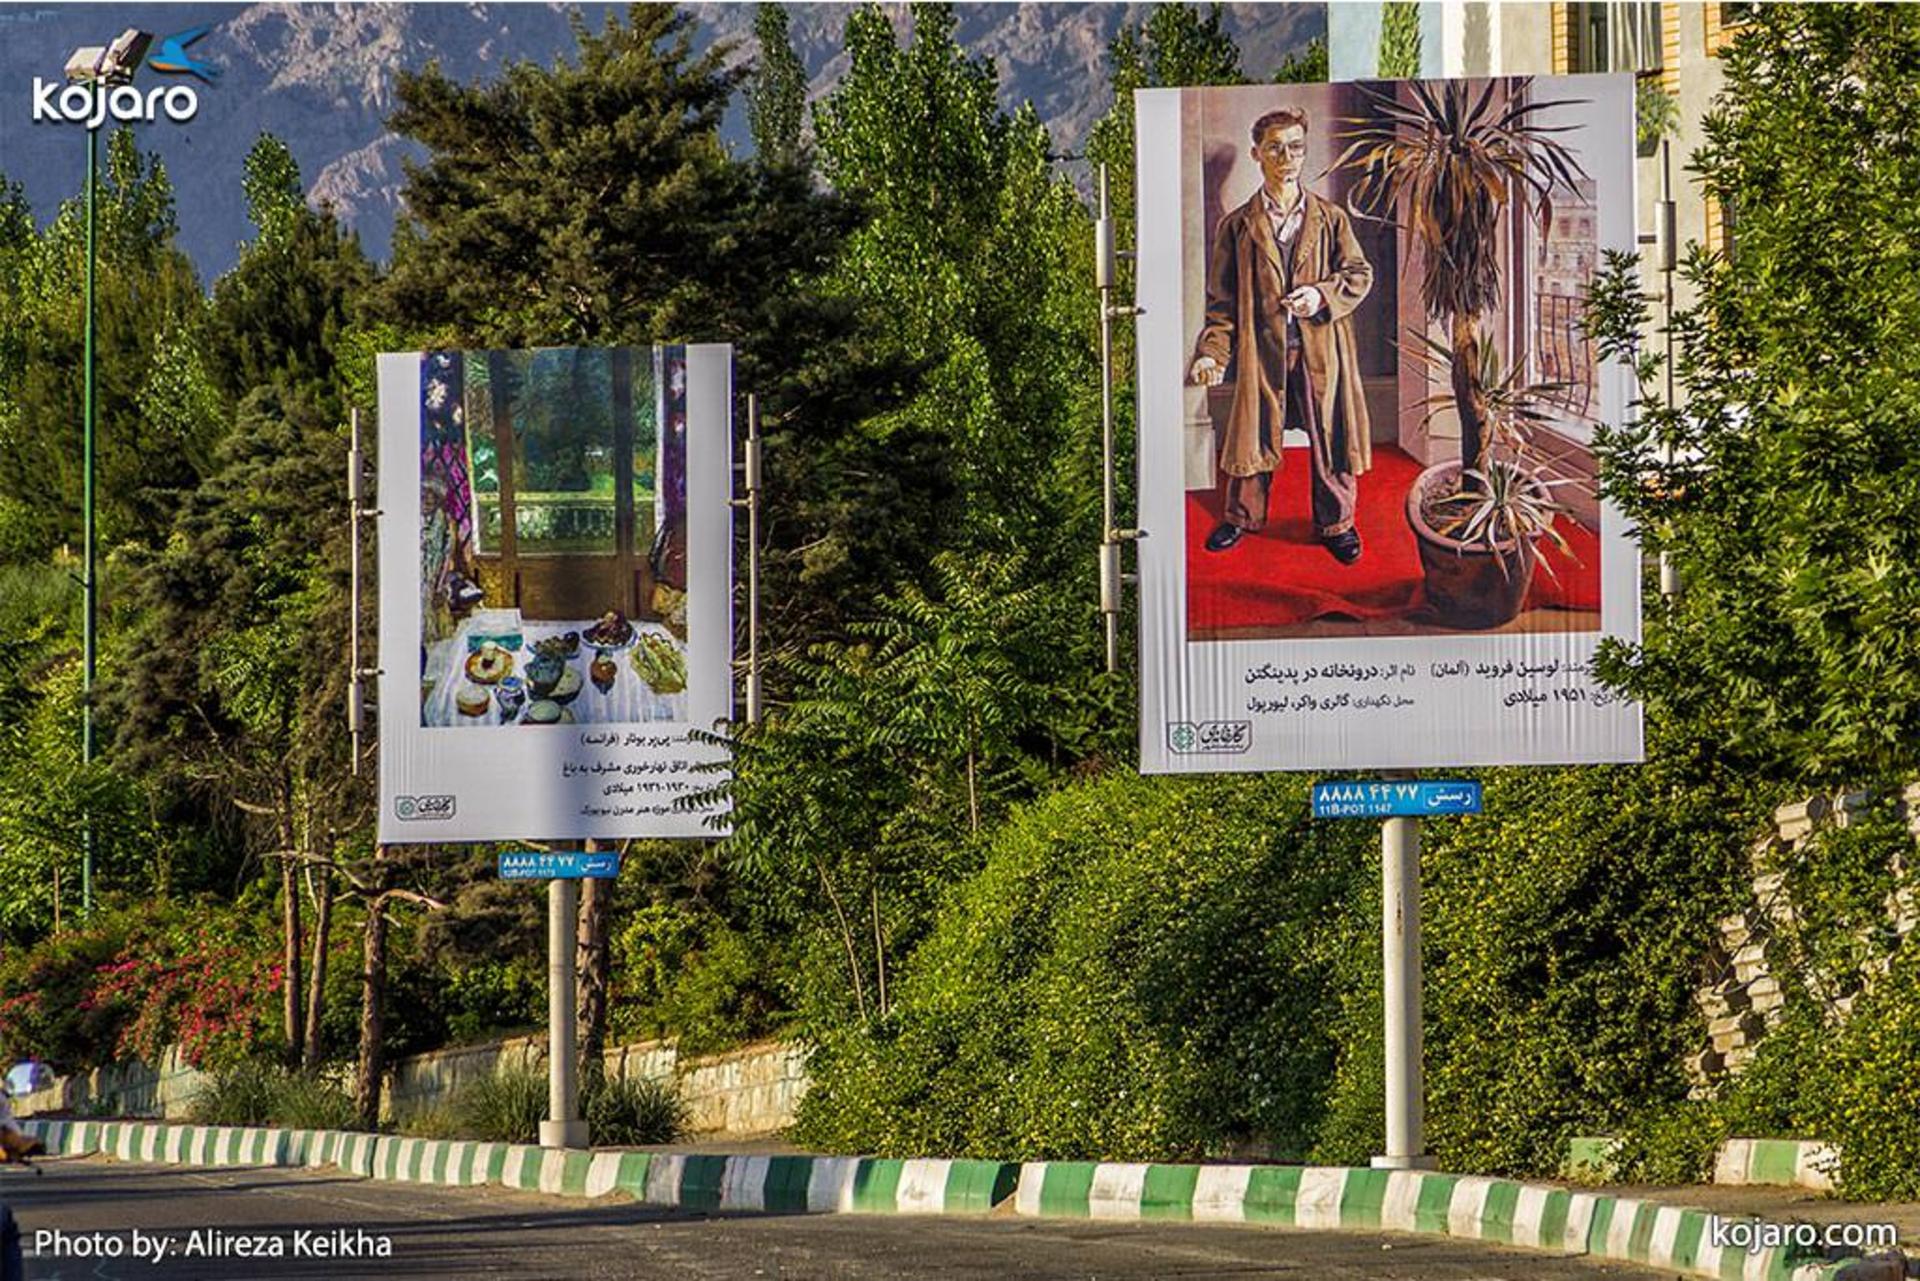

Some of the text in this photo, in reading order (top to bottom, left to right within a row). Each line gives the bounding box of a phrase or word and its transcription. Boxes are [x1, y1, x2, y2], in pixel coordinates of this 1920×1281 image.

[1302, 666, 1318, 682] در
[1475, 661, 1513, 679] فروید
[1503, 689, 1548, 707] میلادی
[1553, 687, 1586, 702] ۱۹۵۱
[1319, 786, 1364, 802] ۸۸۸۸
